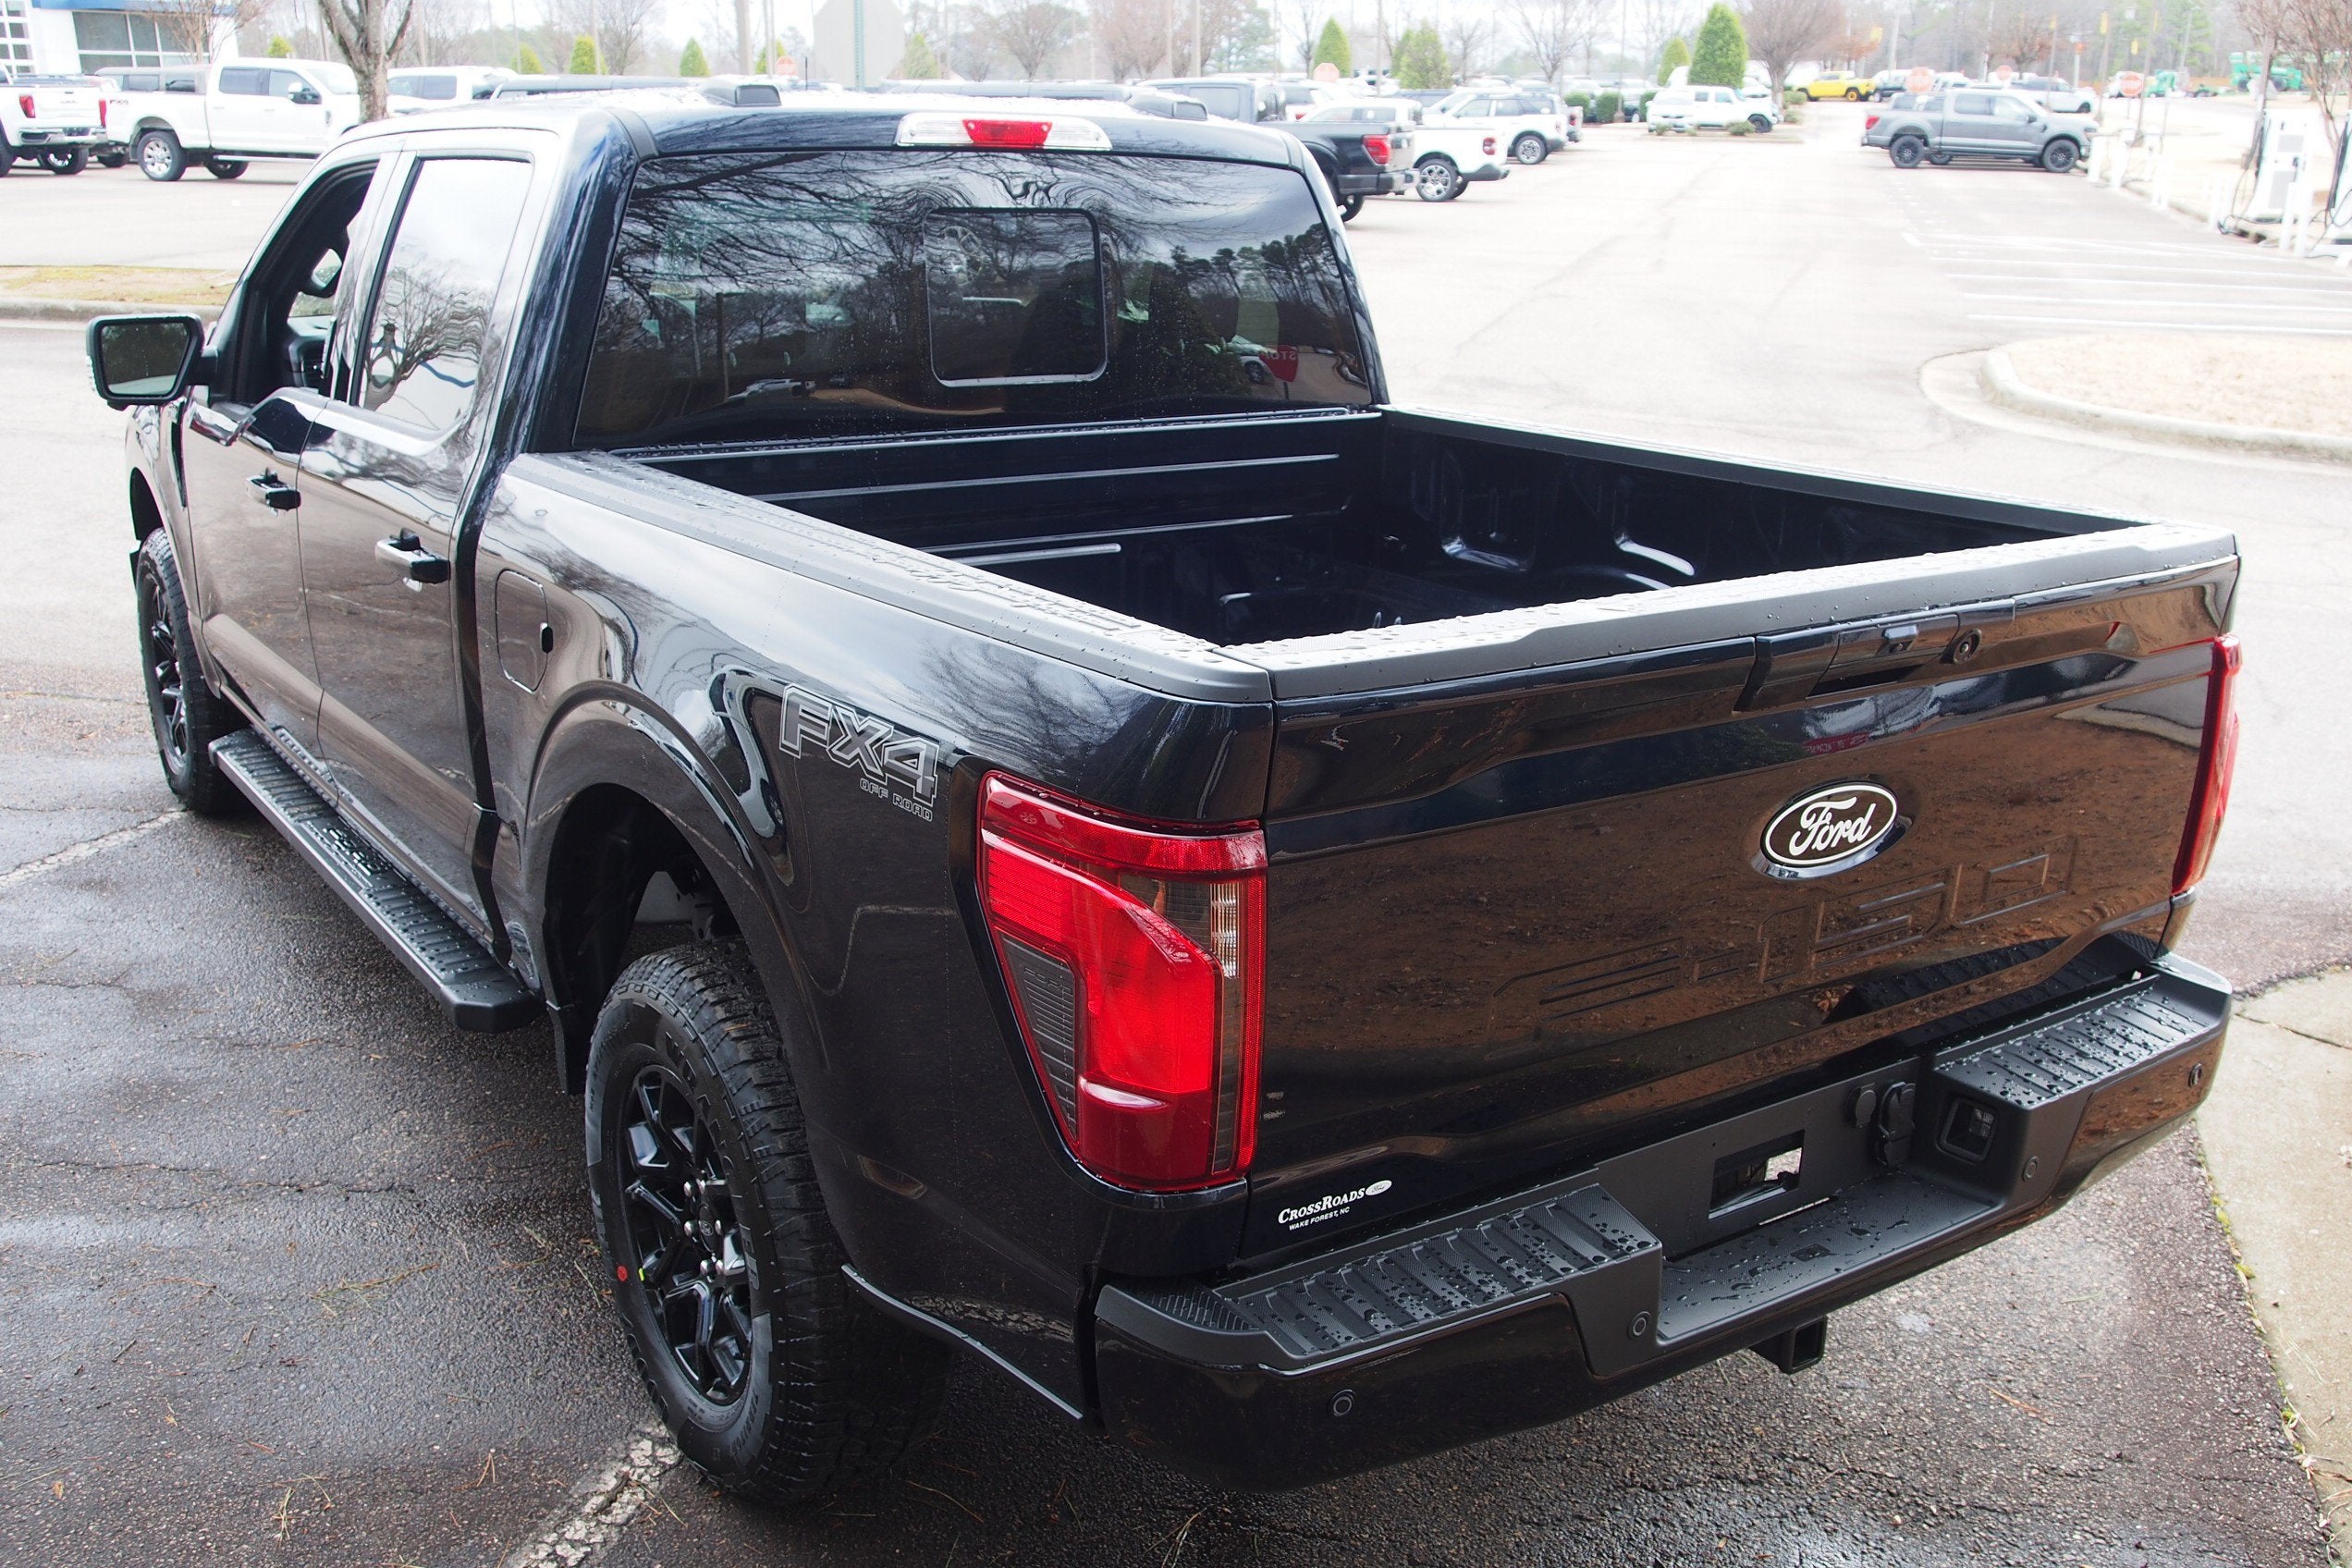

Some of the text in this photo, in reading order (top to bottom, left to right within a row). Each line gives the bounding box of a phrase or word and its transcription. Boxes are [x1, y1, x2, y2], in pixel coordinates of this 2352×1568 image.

[779, 683, 939, 808] FX4
[859, 777, 933, 823] OFF ROAD
[1788, 796, 1876, 857] Ford
[1289, 1206, 1351, 1231] WAKE FOREST, NC
